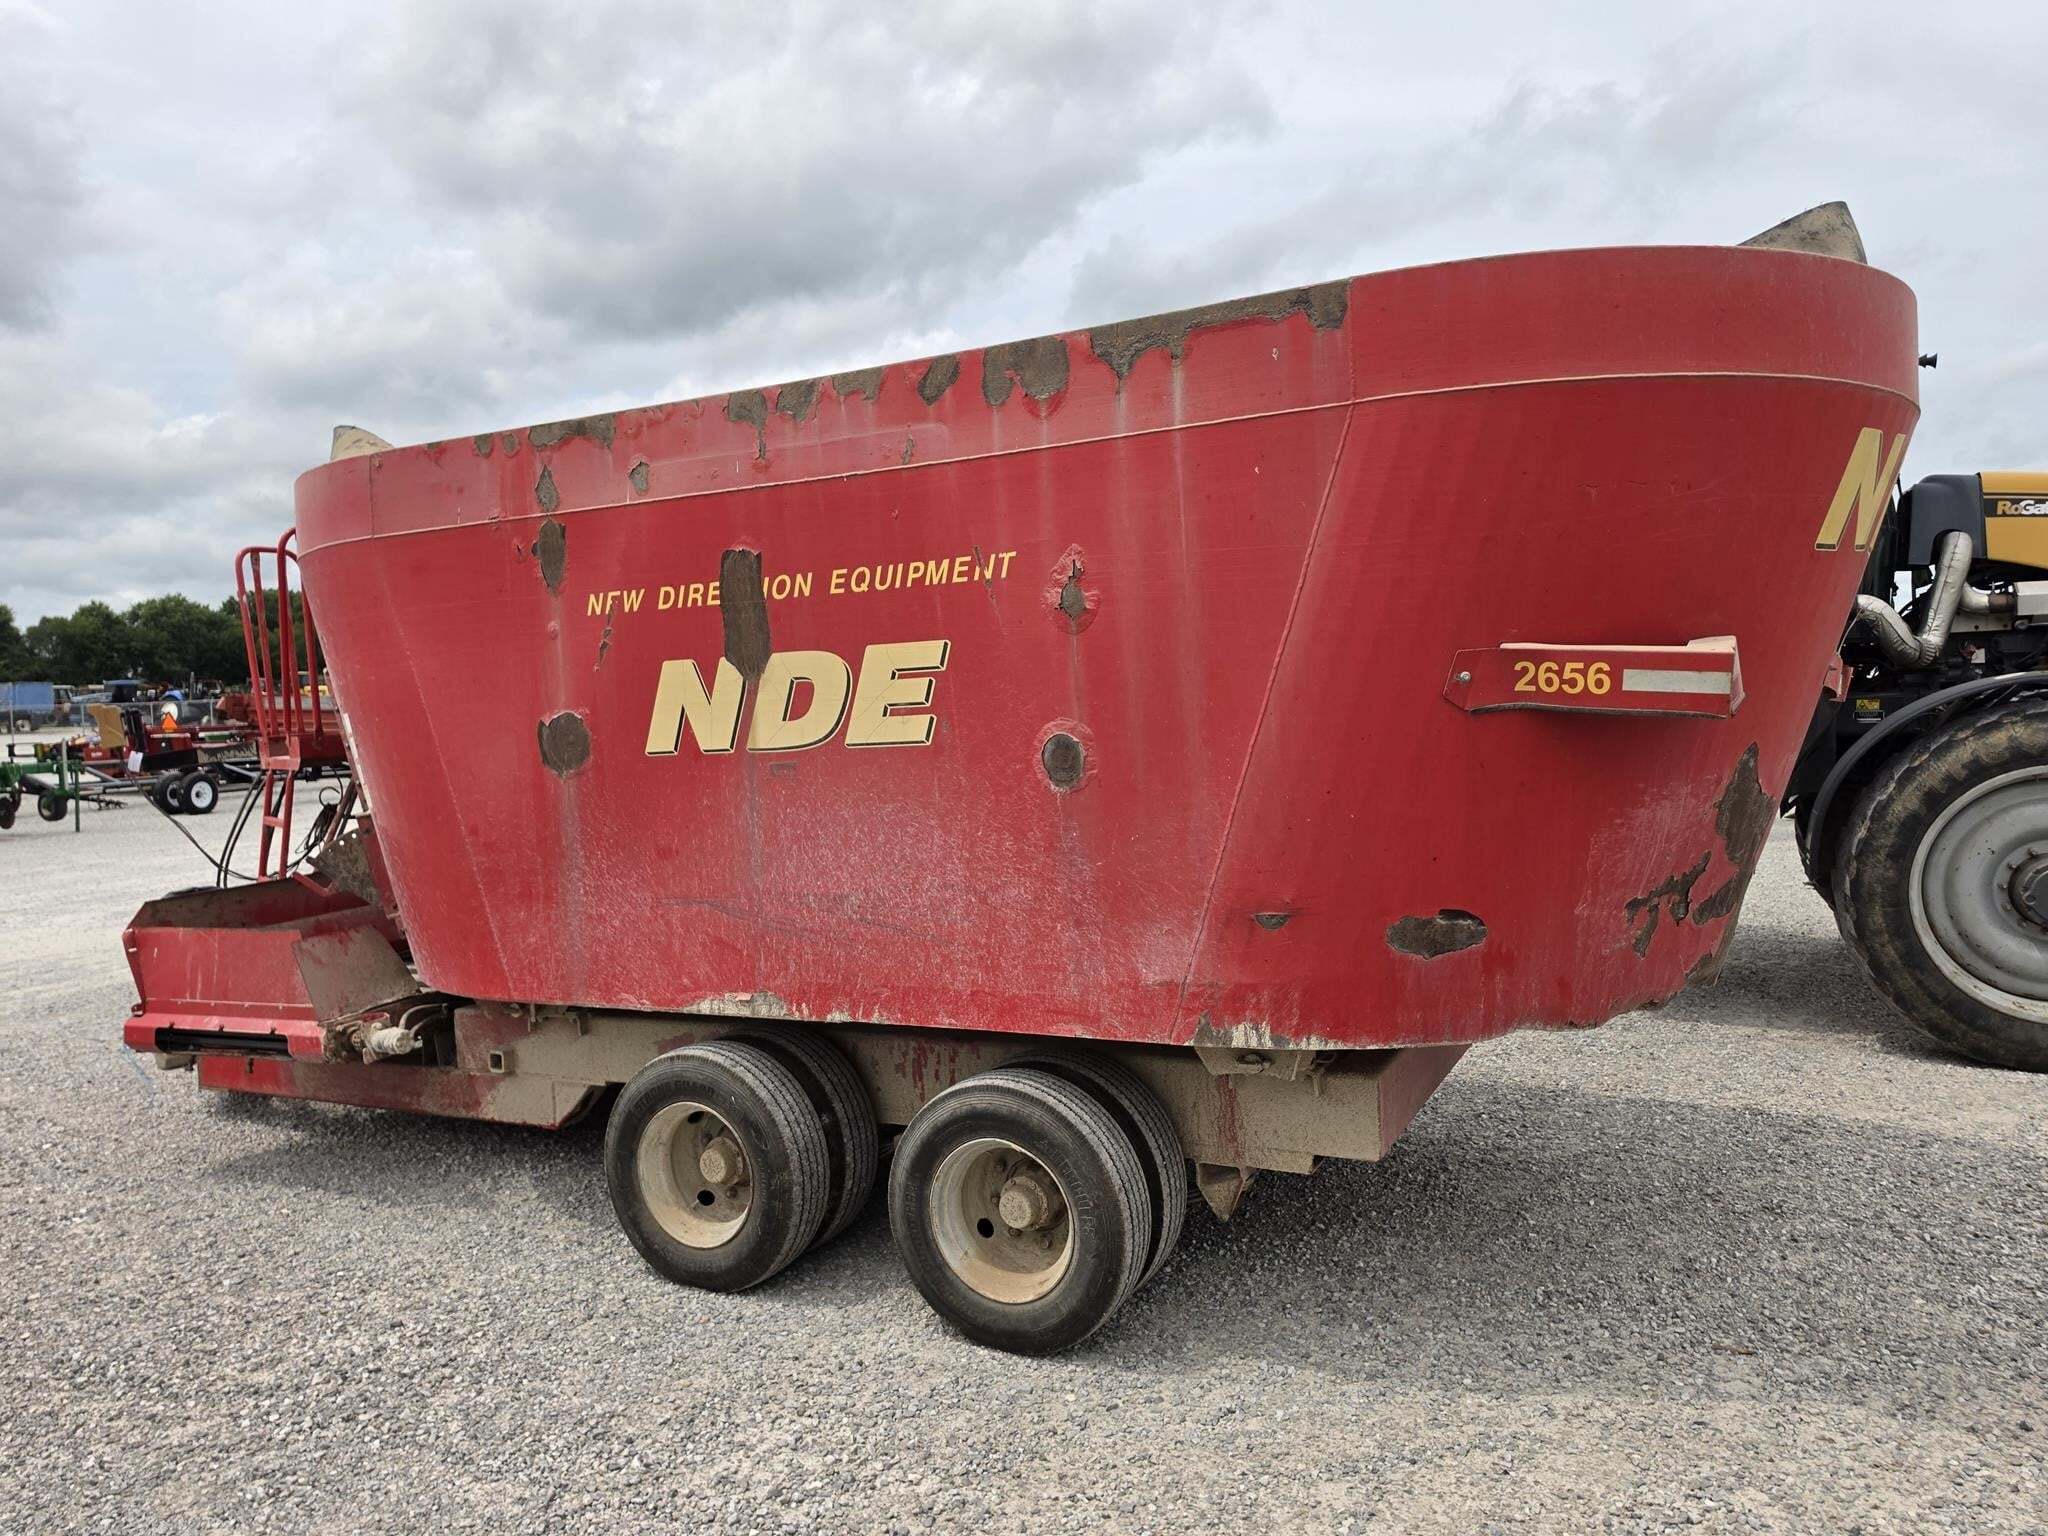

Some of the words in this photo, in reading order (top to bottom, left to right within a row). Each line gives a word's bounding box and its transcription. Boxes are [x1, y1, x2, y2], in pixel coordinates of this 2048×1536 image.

[657, 573, 813, 610] DIREION
[830, 551, 1017, 594] EQUIPMENT
[645, 640, 951, 756] NDE
[1513, 661, 1611, 694] 2656
